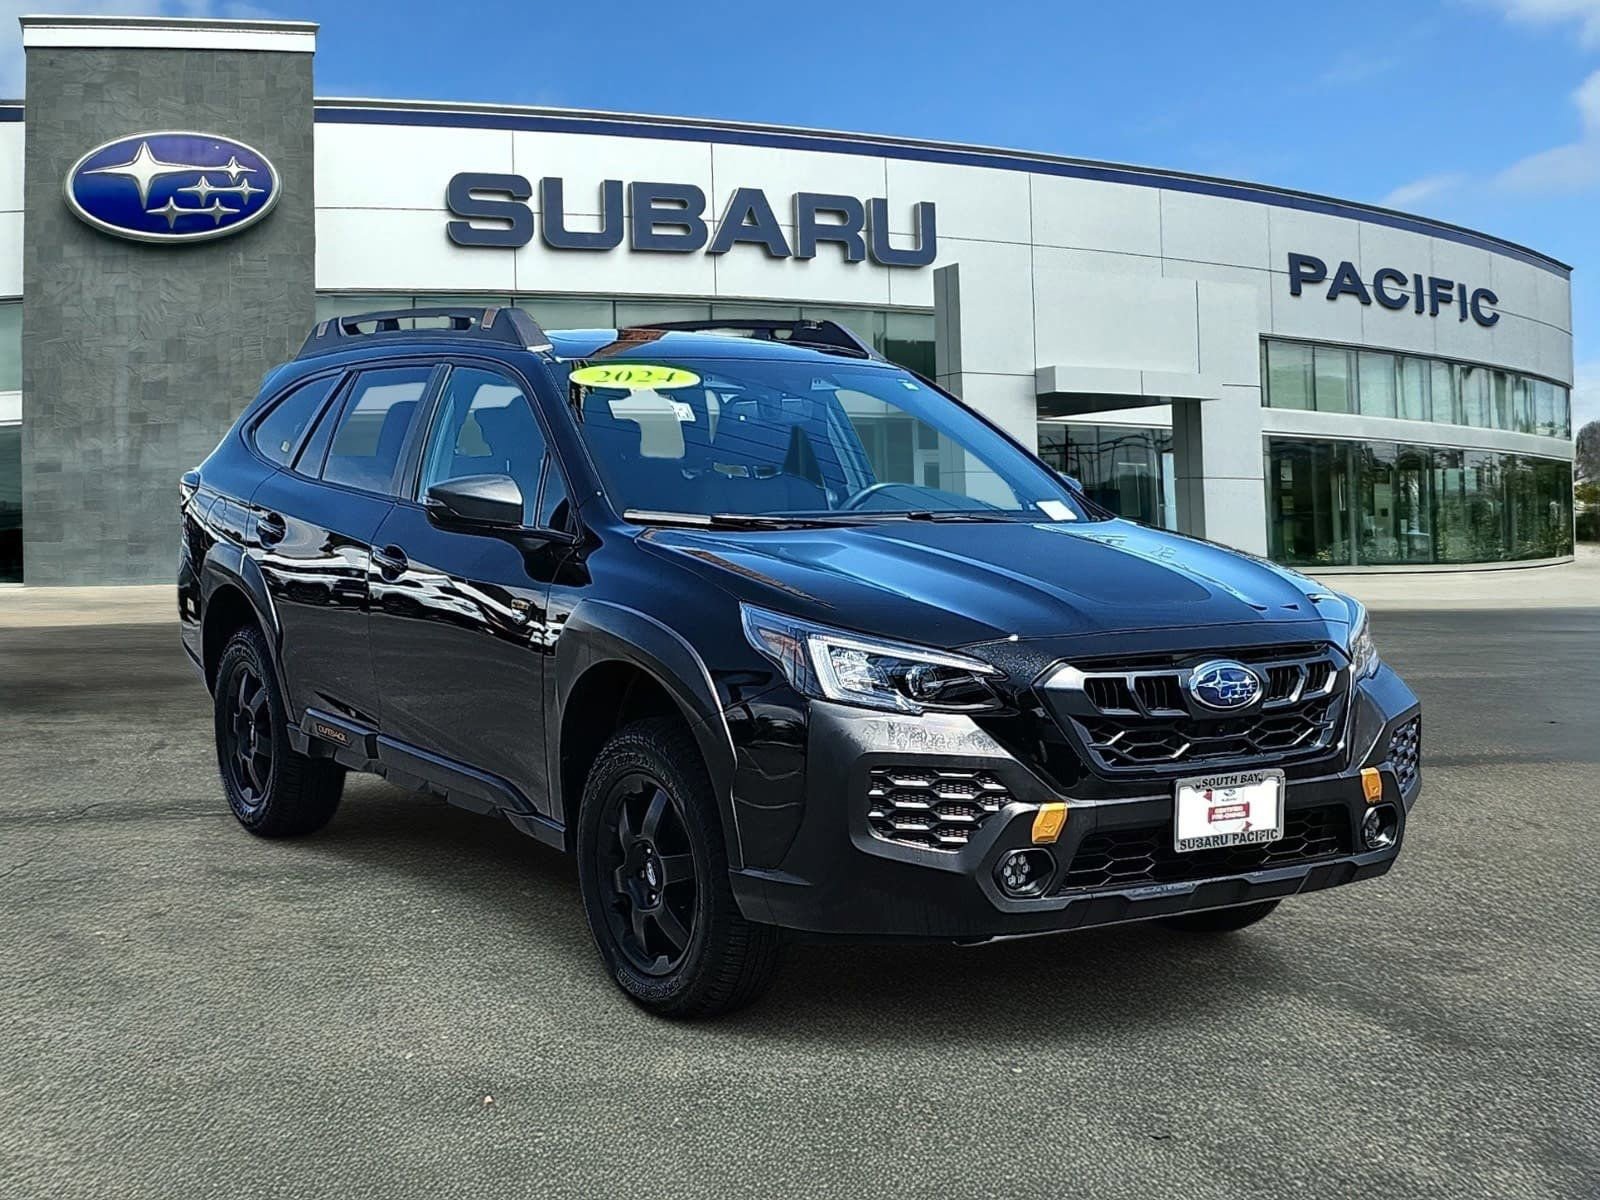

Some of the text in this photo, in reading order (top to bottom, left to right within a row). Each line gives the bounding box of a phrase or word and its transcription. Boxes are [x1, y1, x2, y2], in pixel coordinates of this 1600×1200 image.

[447, 171, 937, 267] SUBARU
[1288, 252, 1500, 327] PACIFIC
[594, 370, 676, 383] 2024
[1201, 772, 1260, 788] SOUTH BAY
[1179, 829, 1279, 851] SUBARU PACIFIC
